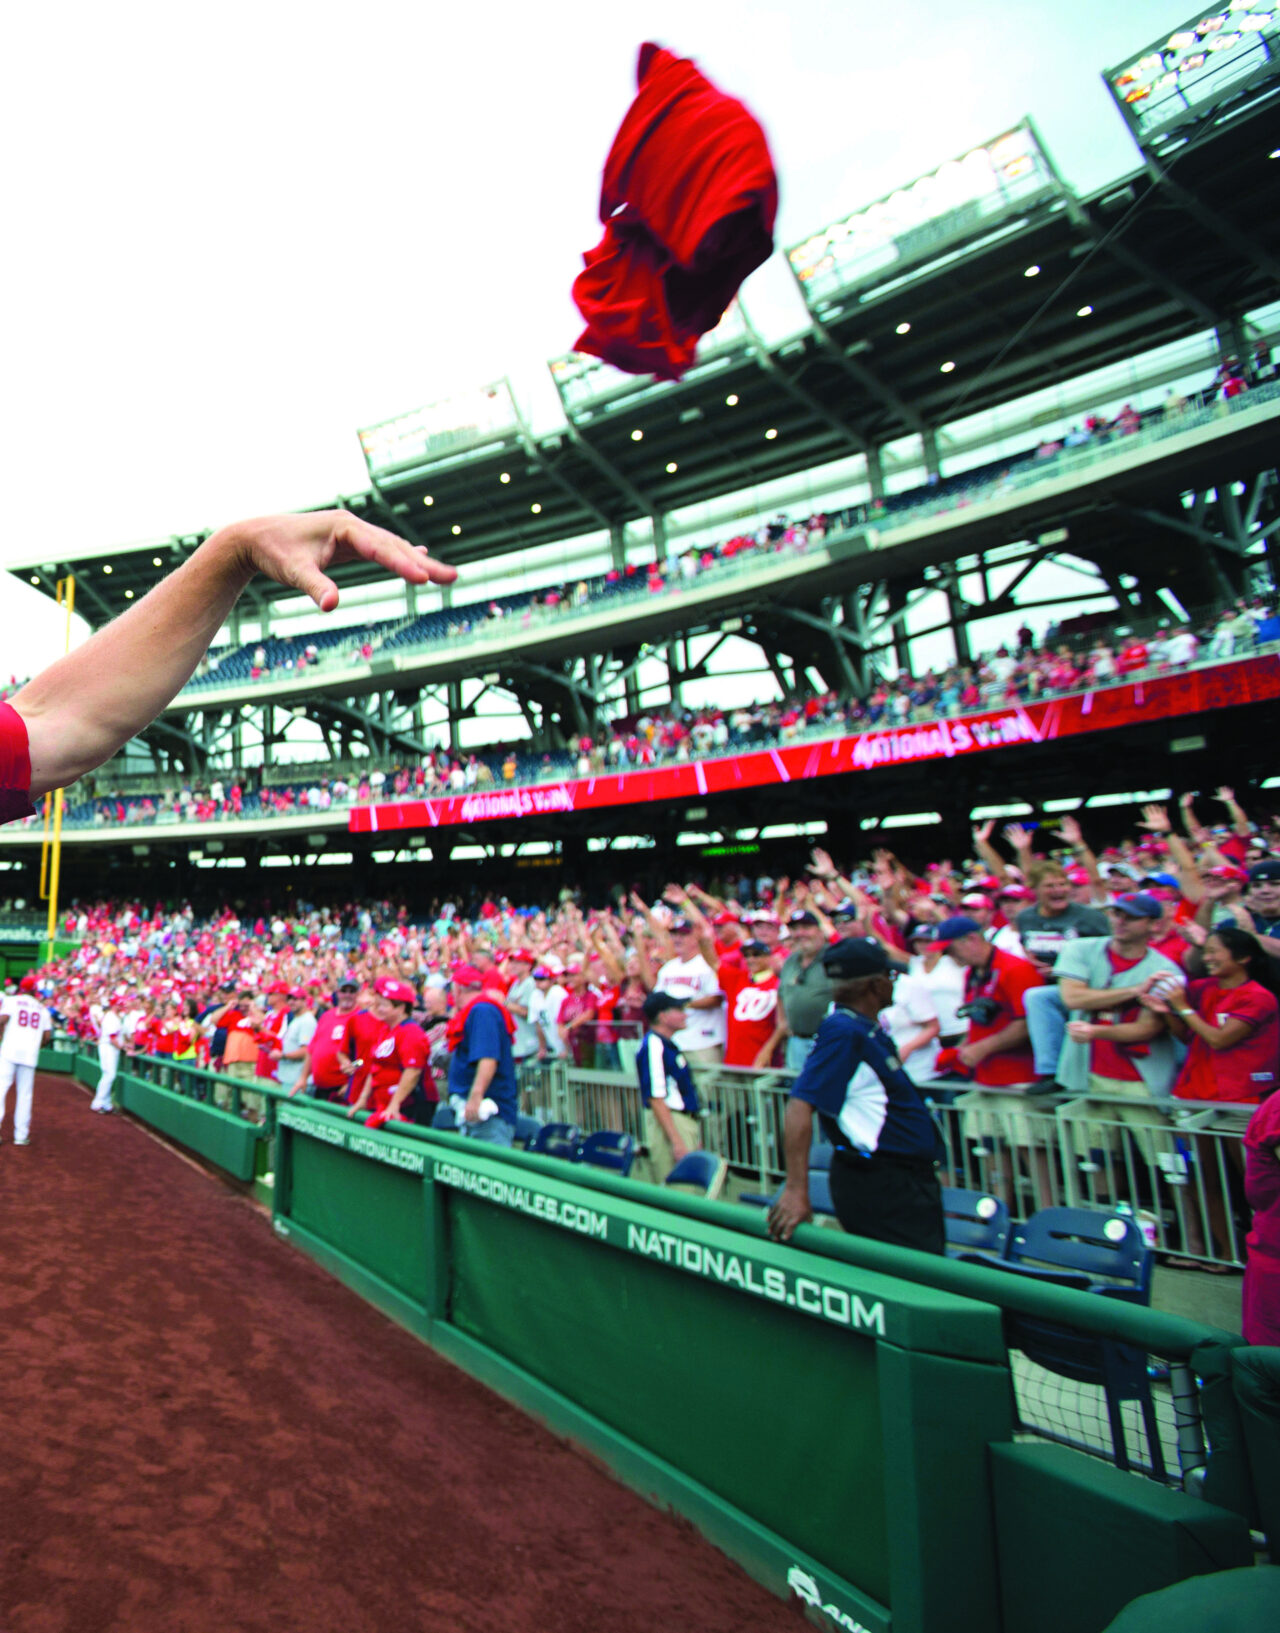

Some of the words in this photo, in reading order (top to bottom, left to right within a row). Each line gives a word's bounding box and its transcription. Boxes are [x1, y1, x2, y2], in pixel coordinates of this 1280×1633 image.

[18, 1009, 41, 1030] 88
[433, 1161, 609, 1240] LOSNACIONALES.COM
[627, 1223, 887, 1337] NATIONALS.COM
